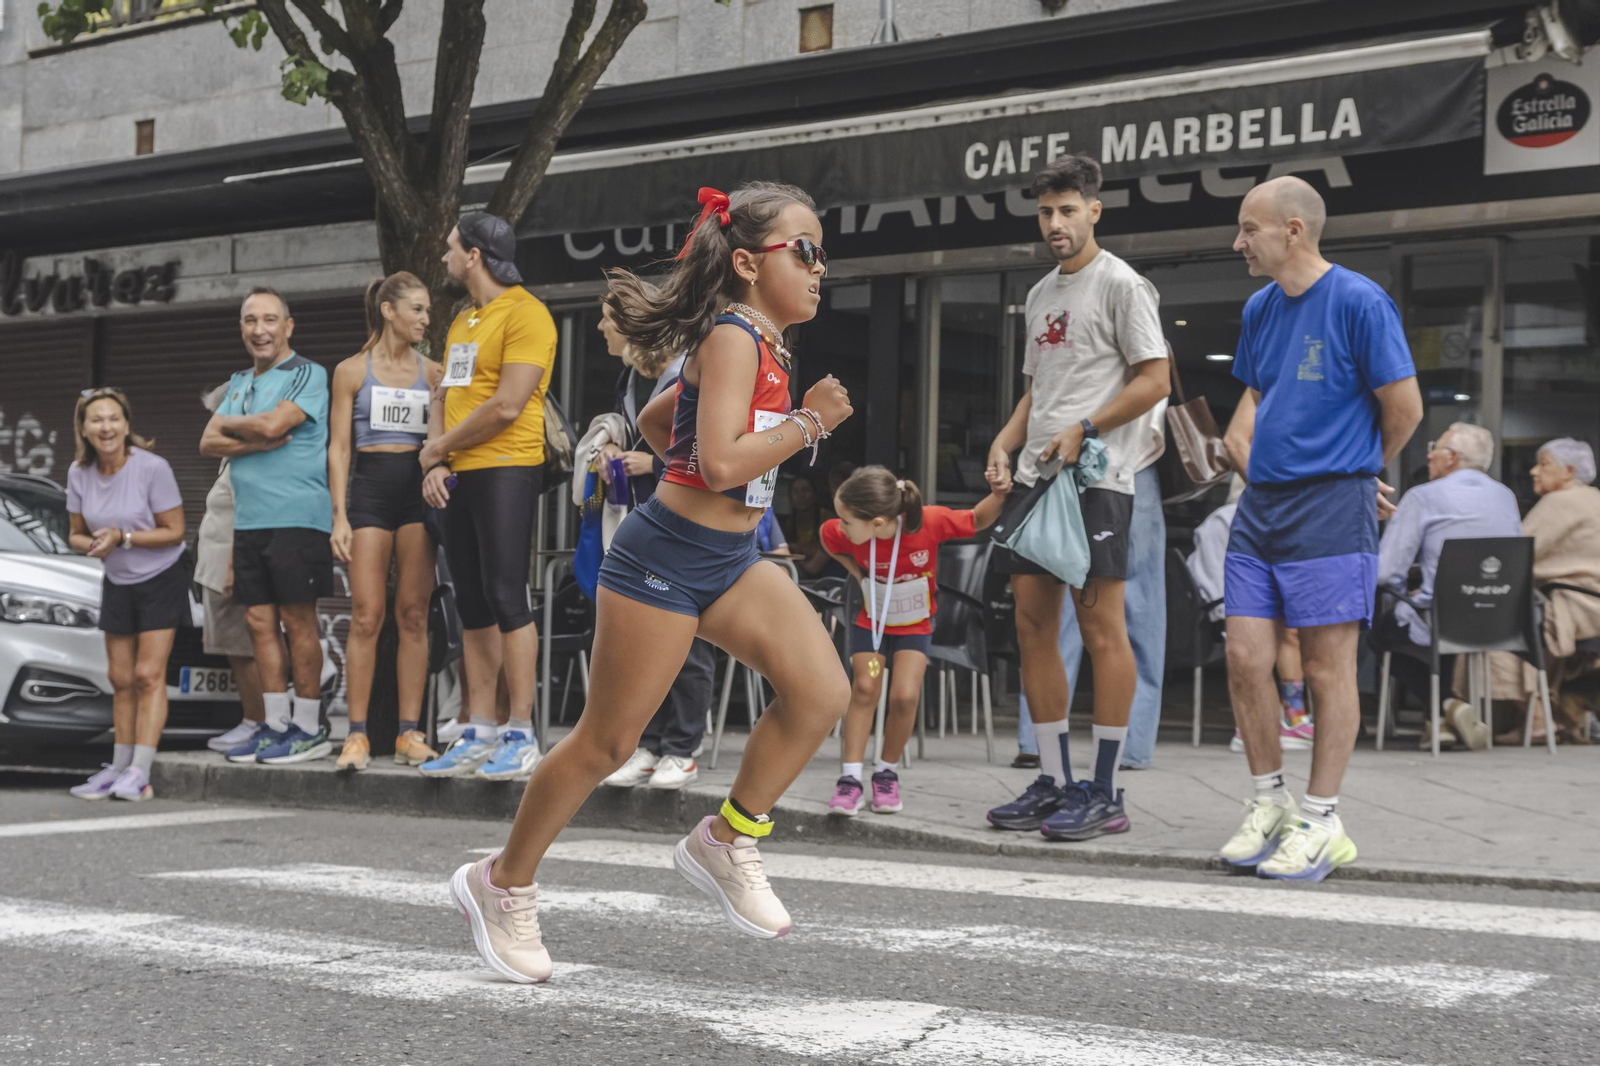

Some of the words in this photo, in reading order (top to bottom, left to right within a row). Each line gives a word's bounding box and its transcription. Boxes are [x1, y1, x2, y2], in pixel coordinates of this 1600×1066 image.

[1511, 94, 1576, 115] Estrella
[1512, 112, 1573, 133] Galicia
[964, 132, 1070, 180] CAFE
[1102, 97, 1362, 164] MARBELLA
[382, 405, 410, 424] 1102
